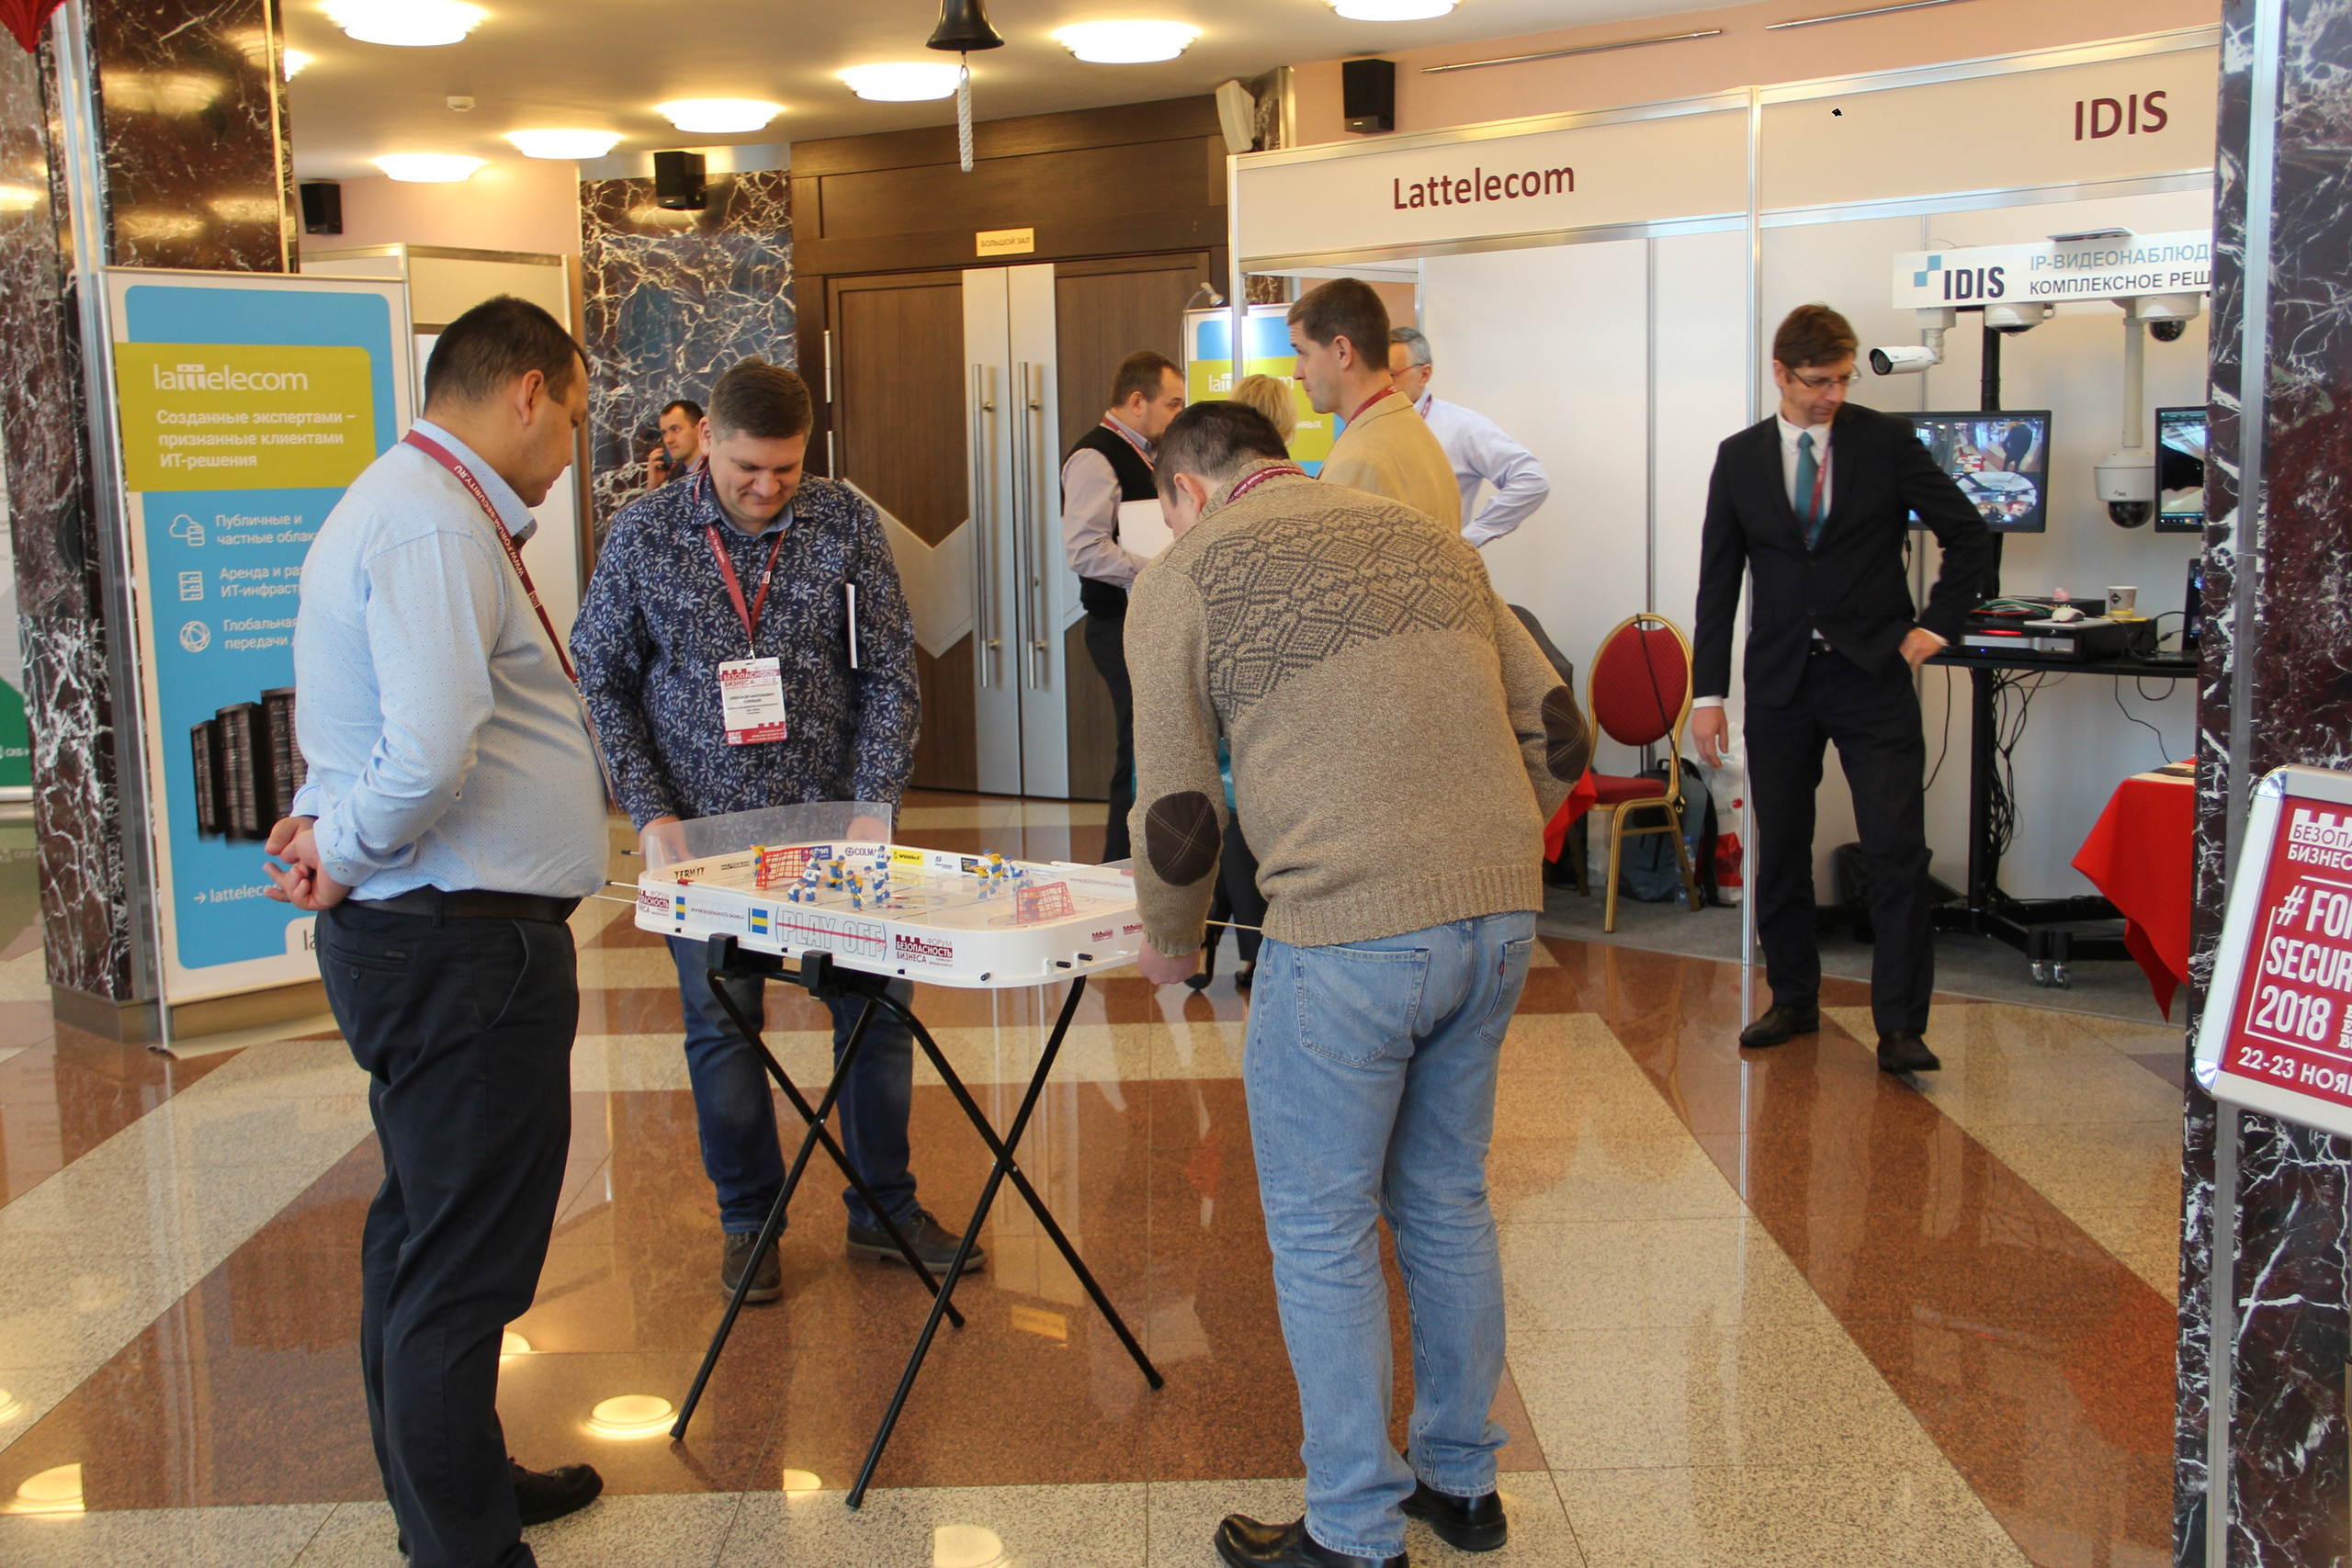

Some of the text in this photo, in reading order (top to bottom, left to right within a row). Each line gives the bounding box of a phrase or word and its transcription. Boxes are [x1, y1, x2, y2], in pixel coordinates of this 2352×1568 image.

[2075, 90, 2167, 141] IDIS
[1394, 167, 1574, 209] Lattelecom
[980, 236, 1030, 247] БОЛЬШОЙ ЗАЛ
[2030, 243, 2211, 271] IP-ВИДЕОНАБЛЮД
[1943, 266, 2006, 300] IDIS
[2030, 274, 2163, 295] КОМПЛЕКСНОЕ
[156, 410, 248, 426] Созданные
[253, 412, 343, 427] экспертами
[158, 433, 344, 449] признанные клиентами
[160, 453, 257, 470] ИТ-решения
[215, 513, 302, 530] Публичные и
[217, 533, 274, 545] частные
[220, 567, 269, 581] Аренда
[273, 568, 281, 576] и
[220, 583, 300, 597] ИТ-инфраст
[224, 636, 288, 651] передачи
[209, 884, 281, 903] lattelec
[782, 910, 881, 957] PLAY OFF
[927, 937, 952, 947] ФОРУМ
[896, 941, 952, 957] БЕЗОПАСНОСТЬ
[897, 951, 926, 964] БИЗНЕСА
[2266, 935, 2352, 993] SECUR
[2255, 985, 2331, 1041] 2018
[2237, 1046, 2295, 1078] 22-23
